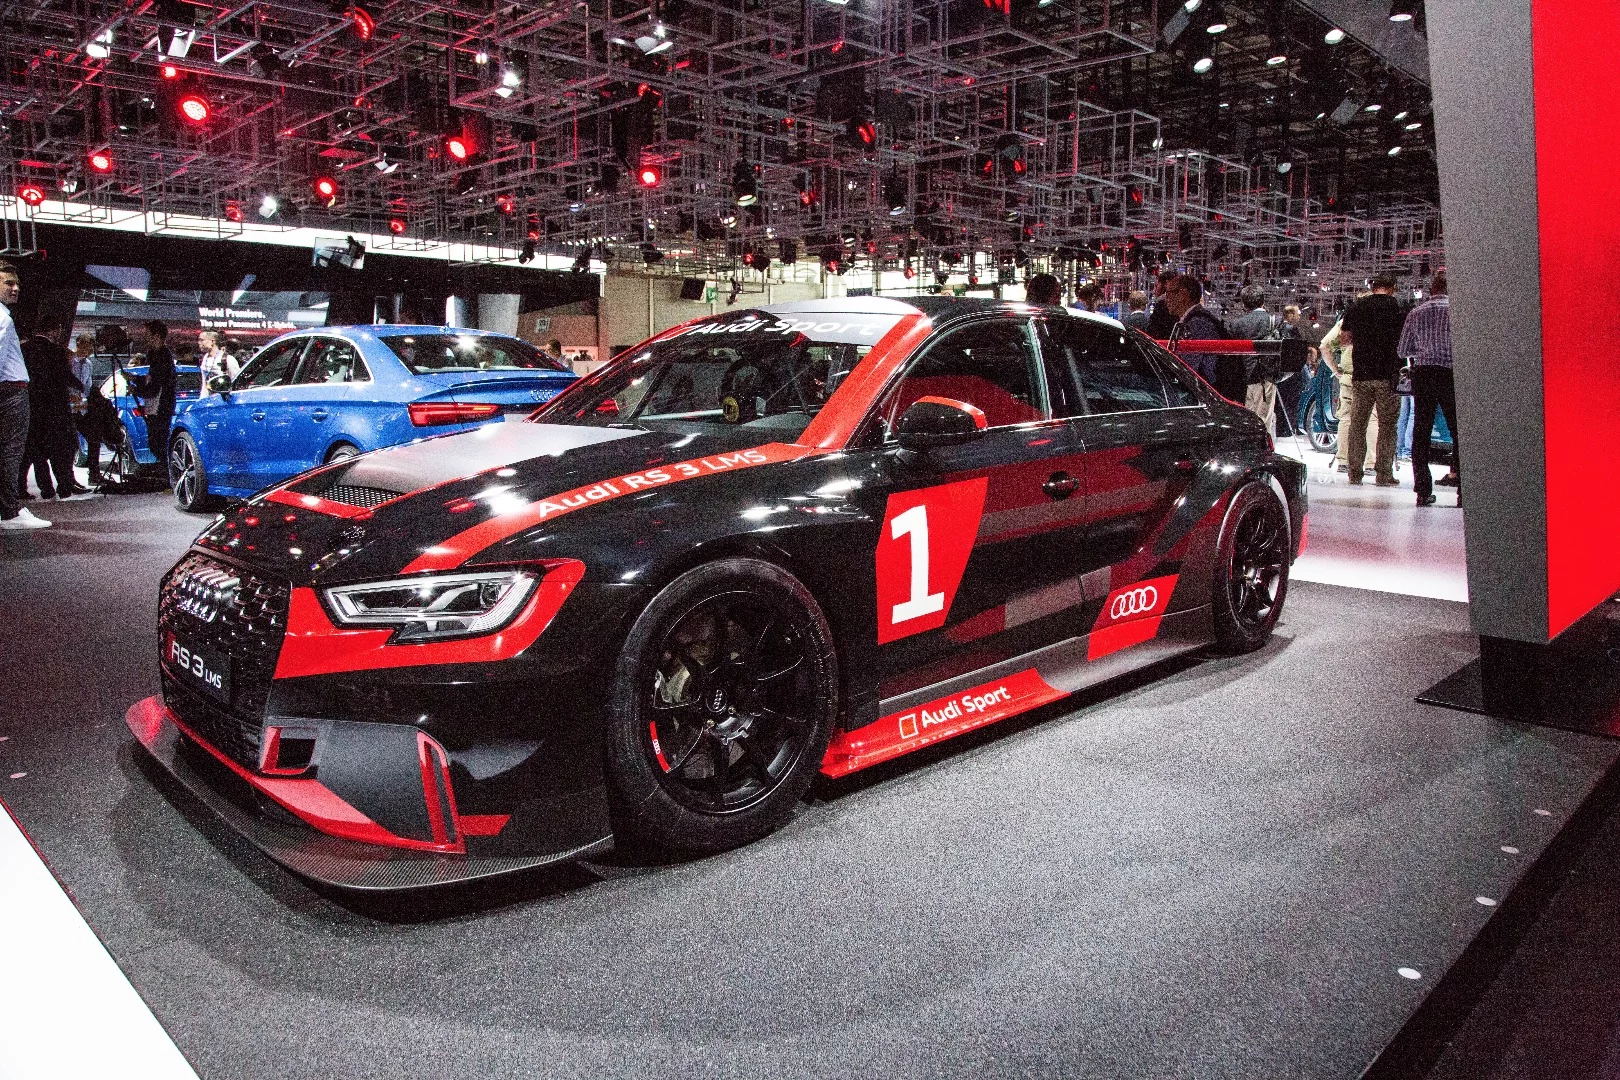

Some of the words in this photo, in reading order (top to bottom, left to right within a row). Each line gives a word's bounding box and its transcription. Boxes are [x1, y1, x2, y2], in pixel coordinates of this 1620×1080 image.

[199, 308, 224, 317] World
[200, 319, 213, 327] The
[700, 319, 769, 335] Audi
[764, 318, 882, 336] Sport
[539, 482, 621, 518] Audi
[622, 469, 672, 489] RS
[674, 463, 700, 476] 3
[701, 450, 767, 471] LMS
[890, 504, 945, 625] 1
[171, 640, 191, 670] RS
[192, 654, 204, 678] 3
[205, 668, 222, 689] LMS
[921, 700, 963, 729] Audi
[961, 686, 1011, 713] Sport
